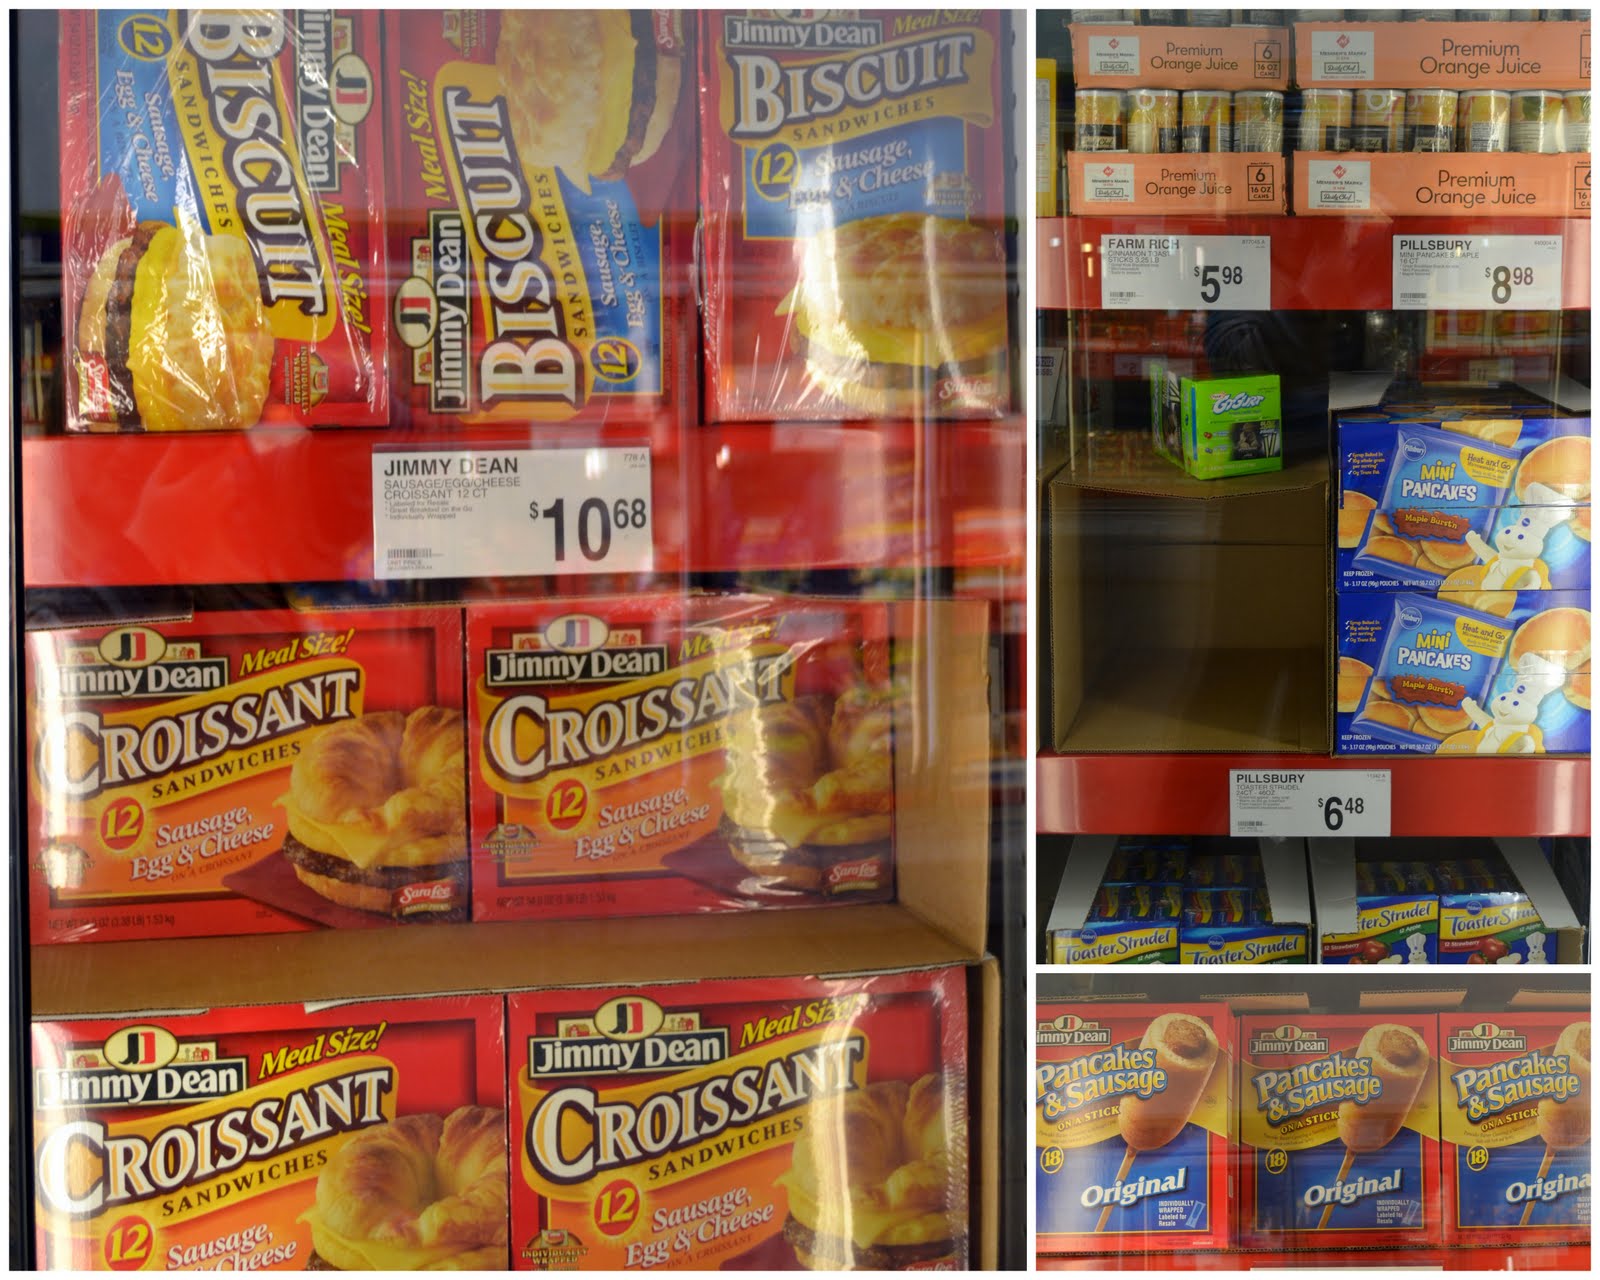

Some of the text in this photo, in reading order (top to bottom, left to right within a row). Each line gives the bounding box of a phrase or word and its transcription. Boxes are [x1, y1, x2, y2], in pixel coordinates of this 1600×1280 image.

[729, 20, 876, 47] Jimmy Dean
[892, 14, 938, 37] Meal
[1166, 42, 1223, 56] Premium
[1442, 39, 1520, 56] Premium
[1150, 56, 1239, 73] Orange Juice
[1257, 63, 1278, 71] 16 OZ
[1420, 57, 1541, 79] Orange Juice
[734, 35, 973, 137] BISCUIT
[793, 95, 935, 141] SANDWICHES
[115, 70, 159, 203] Egg Cheese
[175, 60, 234, 229] SANDWICHES
[301, 104, 331, 186] Dean
[400, 70, 451, 202] Meal Size!
[189, 9, 326, 315] BISCUIT
[760, 152, 794, 186] 12
[858, 160, 935, 193] Cheese
[1161, 169, 1217, 182] Premium
[1145, 182, 1232, 198] Orange Juice
[1438, 170, 1516, 187] Premium
[1416, 187, 1537, 208] Orange Juice
[447, 88, 577, 404] BISCUIT
[607, 200, 630, 266] Cheese
[1108, 238, 1180, 249] FARM RICH
[1400, 240, 1473, 251] PILLSBURY
[538, 172, 588, 337] SANDWICHES
[435, 219, 469, 402] Jimmy Dean
[627, 290, 645, 328] Egg
[599, 345, 629, 377] 12
[384, 457, 519, 477] JIMMY DEAN
[384, 477, 521, 490] SAUSAGE/EGG/CHEESE
[384, 488, 488, 500] CROISSANT 12 CT
[1401, 480, 1477, 501] PANCAKES
[1405, 514, 1428, 524] Maple
[1462, 623, 1479, 633] Heat
[238, 628, 356, 678] Meal Size!
[494, 649, 661, 682] Jimmy Dean
[1397, 647, 1472, 671] PANCAKES
[148, 664, 221, 689] Dean
[1402, 680, 1425, 690] Maple
[488, 655, 792, 778] CROISSANT
[41, 670, 359, 796] CROISSANT
[152, 740, 301, 799] SANDWICHES
[595, 726, 738, 782] SANDWICHES
[1236, 774, 1305, 783] PILLSBURY
[549, 783, 585, 819] 12
[598, 785, 690, 828] Sausage,
[103, 807, 141, 841] 12
[156, 805, 254, 848] Sausage,
[574, 836, 615, 862] Egg
[640, 802, 711, 838] Cheese
[130, 853, 174, 882] Egg
[199, 822, 274, 858] Cheese
[1378, 903, 1431, 927] Strudel
[1406, 923, 1422, 933] Apple
[1444, 914, 1499, 936] Toaster
[1525, 922, 1541, 931] Apple
[1056, 931, 1171, 963] Toaster Strudel
[1145, 952, 1161, 960] Apple
[1245, 937, 1298, 960] Strudel
[1330, 942, 1360, 951] Strawberry
[1451, 939, 1480, 949] Strawberry
[738, 998, 858, 1048] Meal Size!
[1073, 1030, 1108, 1043] Dean
[258, 1021, 388, 1080] Meal Size!
[536, 1037, 721, 1073] Jimmy Dean
[1251, 1039, 1325, 1055] Jimmy Dean
[1450, 1037, 1523, 1051] Jimmy Dean
[157, 1067, 239, 1094] Dean
[1036, 1047, 1155, 1098] Pancakes
[1255, 1053, 1371, 1103] Pancakes
[1454, 1051, 1568, 1102] Pancakes
[1067, 1070, 1166, 1108] Sausage
[1288, 1076, 1381, 1114] Sausage
[1488, 1074, 1579, 1111] Sausage
[531, 1038, 864, 1182] CROISSANT
[1084, 1105, 1120, 1121] STICK
[1305, 1111, 1339, 1127] STICK
[1505, 1107, 1538, 1123] STICK
[39, 1070, 392, 1214] CROISSANT
[648, 1117, 805, 1182] SANDWICHES
[1469, 1149, 1486, 1165] 18
[1044, 1150, 1062, 1167] 18
[1269, 1151, 1285, 1167] 18
[162, 1149, 330, 1218] SANDWICHES
[1081, 1168, 1186, 1208] Original
[1304, 1169, 1402, 1205] Original
[1506, 1172, 1592, 1203] Origina
[598, 1188, 636, 1226] 12
[652, 1185, 753, 1233] Sausage,
[109, 1224, 149, 1264] 12
[166, 1224, 275, 1270] Sausage,
[624, 1202, 775, 1269] Egg Cheese
[215, 1241, 298, 1271] Cheese
[532, 1256, 578, 1265] WRAPPED
